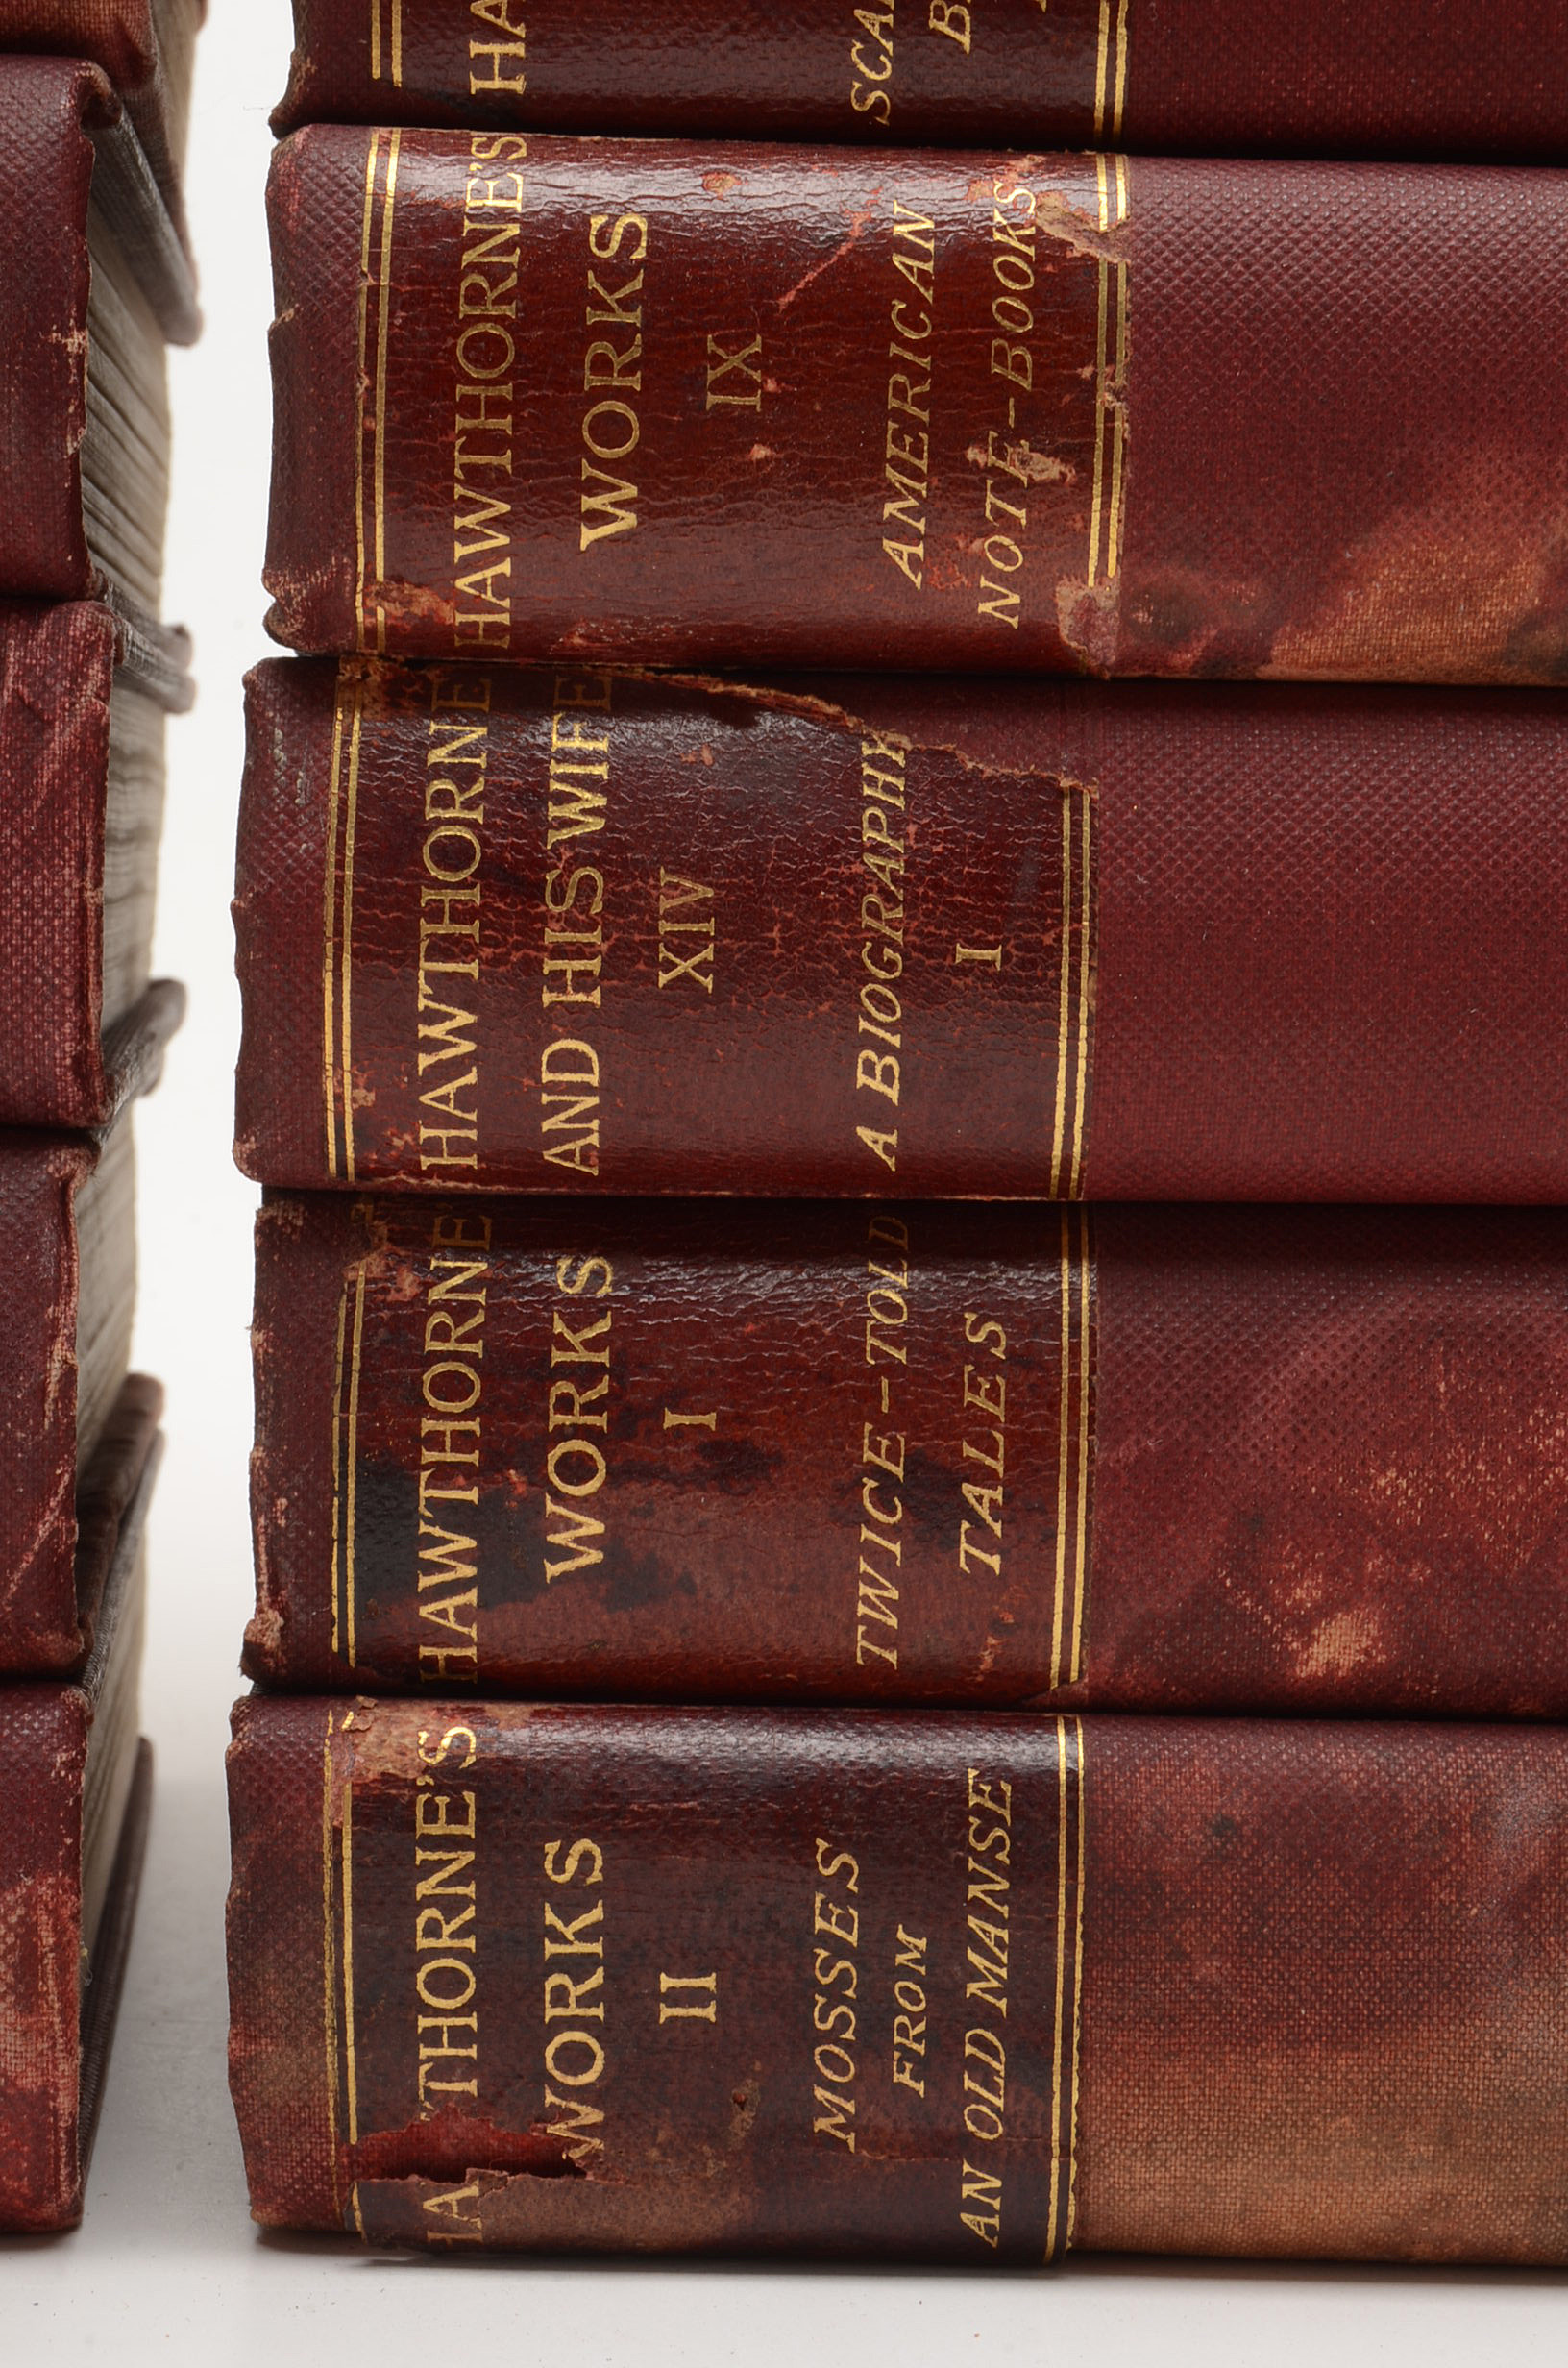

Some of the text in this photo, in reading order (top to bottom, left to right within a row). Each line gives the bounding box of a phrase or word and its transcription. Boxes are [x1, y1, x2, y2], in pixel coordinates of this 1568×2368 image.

[850, 0, 894, 127] SCA
[929, 0, 971, 55] B
[454, 136, 527, 649] HAWTHORNE'S
[579, 212, 649, 551] WORKS
[706, 333, 762, 412] IX
[882, 200, 936, 591] AMERICAN
[978, 180, 1038, 629] NOTE-BOOKS
[418, 677, 491, 1170] HAWTHORNE
[541, 676, 612, 1176] AND HIS WIFE
[658, 865, 715, 994] XIV
[856, 729, 907, 1172] A BIOGRAPHY
[955, 943, 1002, 971] I
[545, 1255, 613, 1584] WORKS
[664, 1407, 716, 1431] I
[857, 1215, 910, 1670] TWICE-TOLD
[960, 1312, 1008, 1576] TALES
[416, 1726, 482, 2244] ATHORNE'S
[659, 1971, 717, 2024] II
[814, 1837, 860, 2154] MOSSES
[894, 1924, 927, 2098] FROM
[960, 1768, 1012, 2249] AN OLD MANSE
